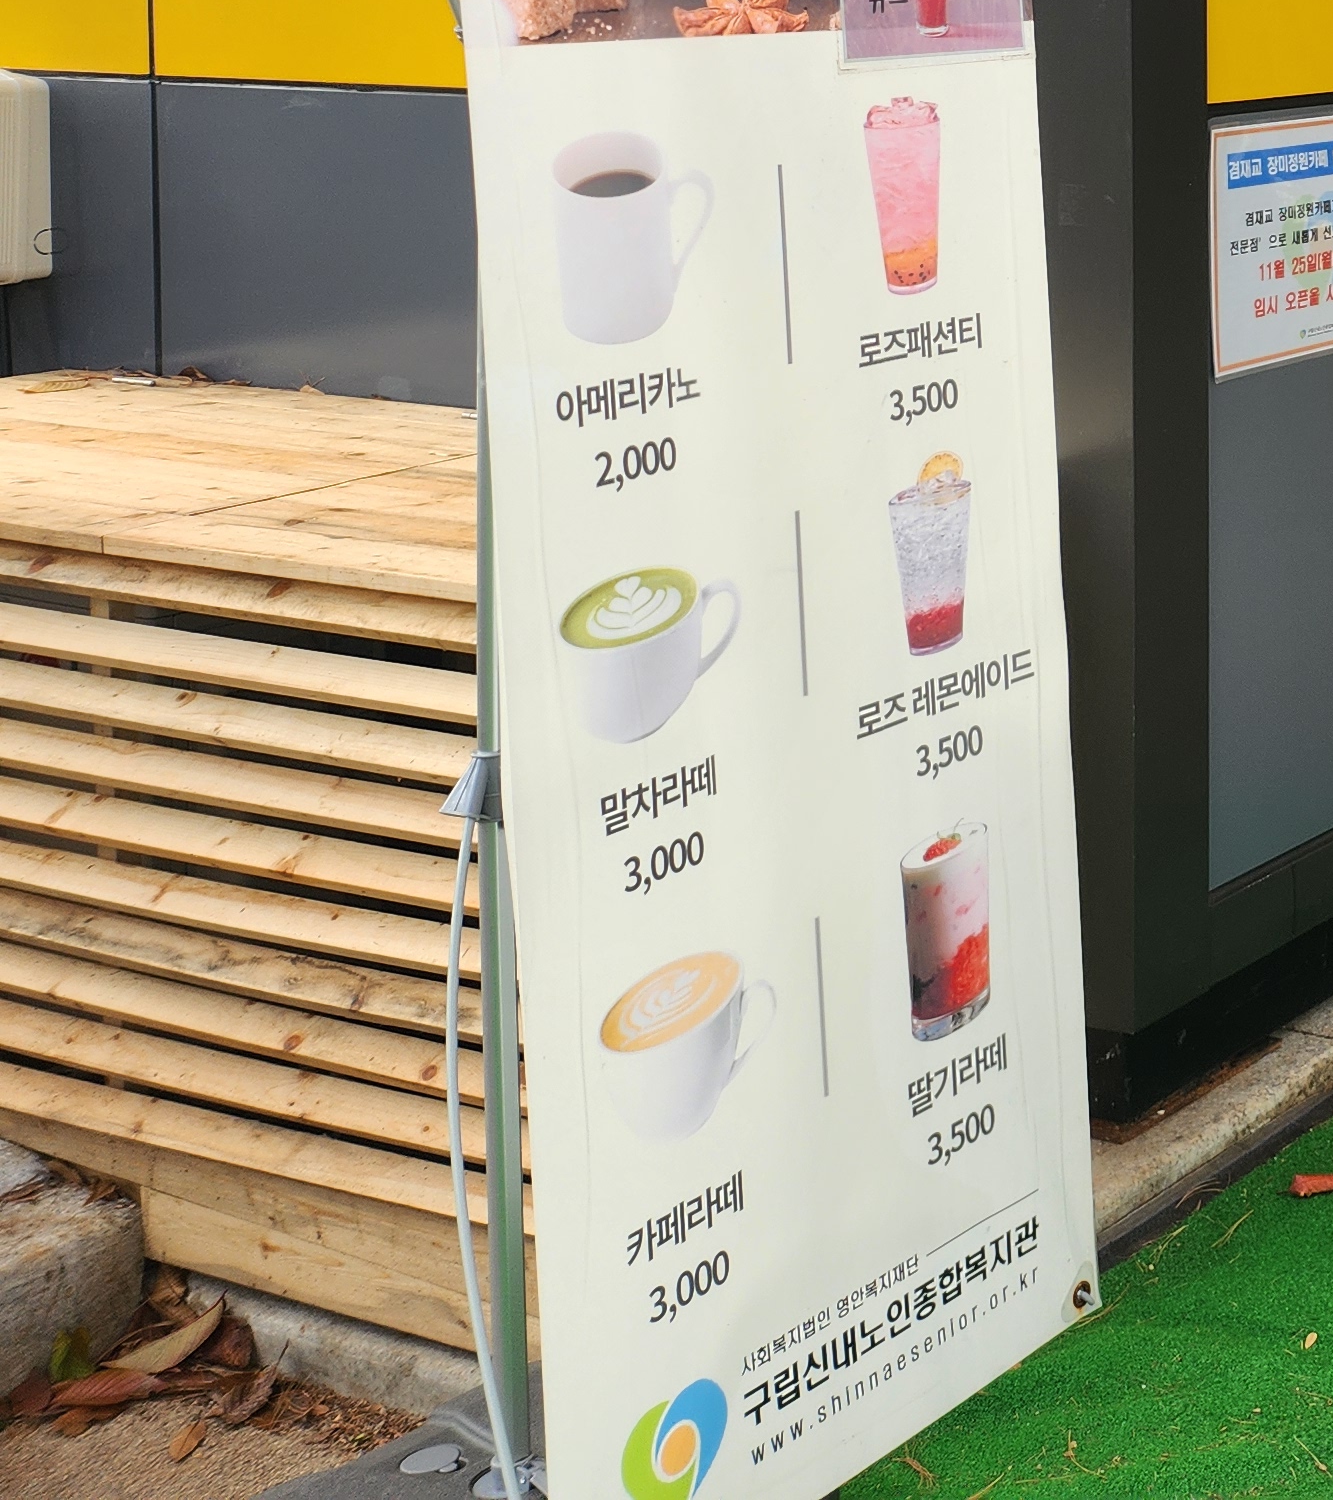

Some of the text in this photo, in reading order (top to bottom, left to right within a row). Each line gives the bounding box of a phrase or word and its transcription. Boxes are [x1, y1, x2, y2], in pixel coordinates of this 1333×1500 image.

[1228, 158, 1262, 181] 겸재교
[1267, 149, 1329, 176] 장미정원카페
[1245, 208, 1273, 227] 겸재교
[1268, 232, 1287, 249] 으로
[1291, 227, 1319, 245] 새롭게
[1259, 258, 1285, 281] 11월
[1254, 295, 1278, 318] 임시
[1285, 286, 1320, 311] 오픈을
[859, 312, 984, 368] 로즈패션티
[556, 366, 702, 428] 아메리카노
[889, 378, 959, 427] 3,500
[594, 437, 677, 492] 2,000
[856, 649, 1036, 741] 로즈 레몬에이드
[916, 724, 984, 781] 3,500
[600, 754, 718, 837] 말차라떼
[623, 830, 705, 895] 3,000
[907, 1033, 1008, 1118] 딸기라떼
[927, 1103, 996, 1166] 3,500
[626, 1169, 745, 1267] 카페라떼
[648, 1250, 730, 1324] 3,000
[740, 1253, 920, 1377] 사회복지법인 영안복지재단
[742, 1216, 1041, 1427] 구립신내노인종합복지관
[751, 1267, 1040, 1466] www.shinnaesenior.or.kr
